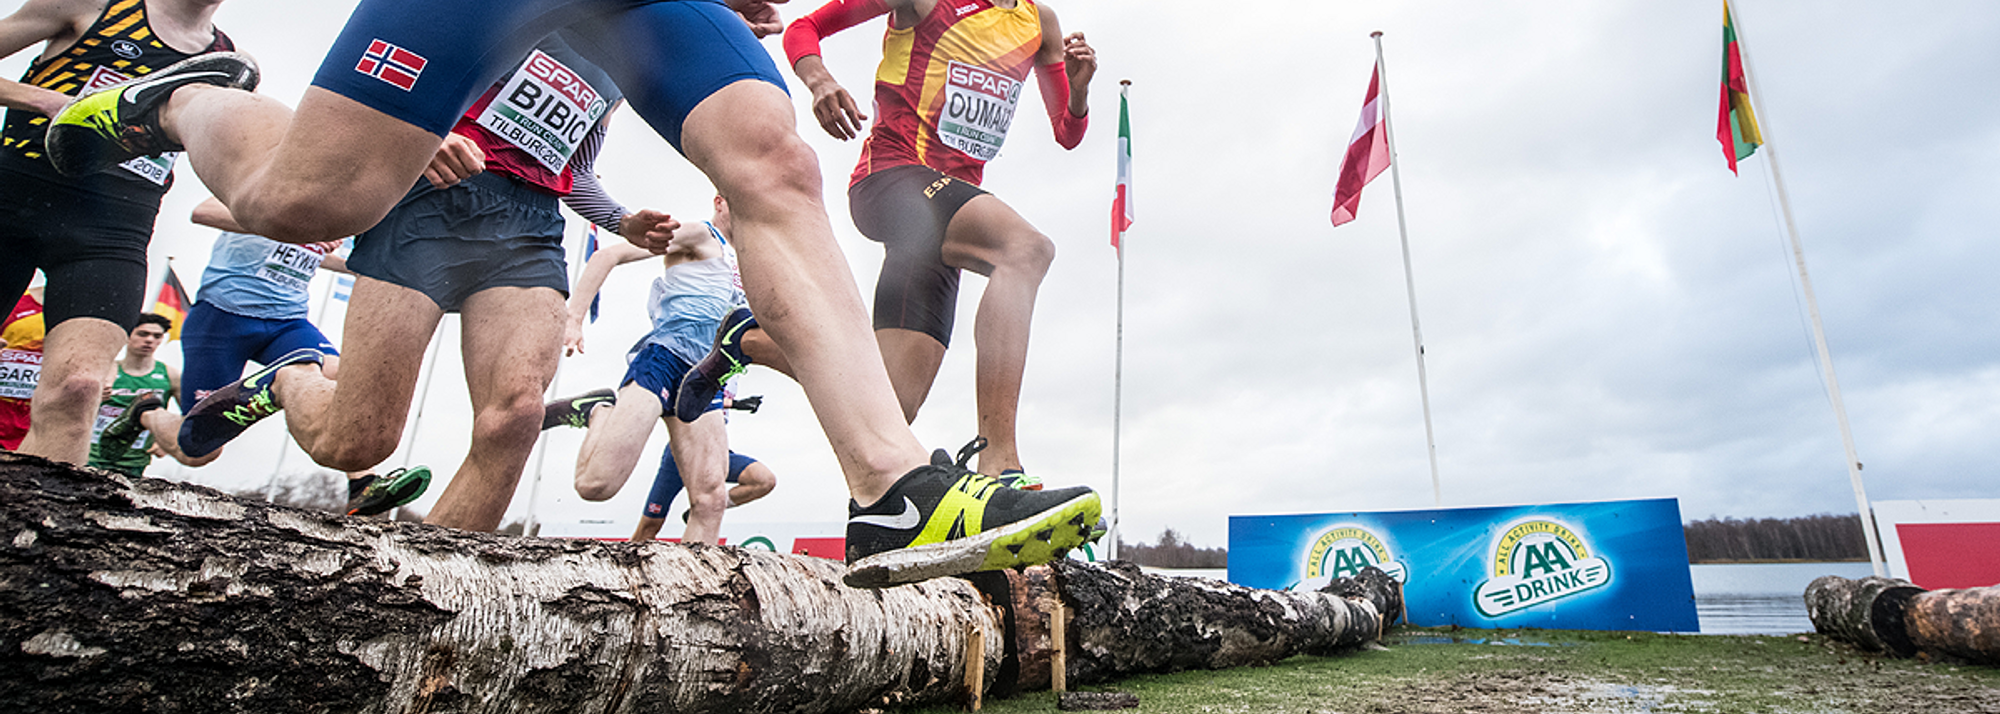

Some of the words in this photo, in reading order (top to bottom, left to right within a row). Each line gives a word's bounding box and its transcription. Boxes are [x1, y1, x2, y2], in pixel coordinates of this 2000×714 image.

[529, 57, 594, 110] SPAR
[951, 67, 1010, 97] SPAR
[507, 78, 587, 145] BIBIC
[133, 159, 164, 181] 2018
[1321, 529, 1357, 547] ACTIVITY
[1498, 545, 1510, 564] ALL
[1508, 522, 1549, 542] ACTIVITY
[1332, 546, 1371, 578] AA
[1522, 541, 1572, 579] AA
[1515, 568, 1585, 602] DRINK
